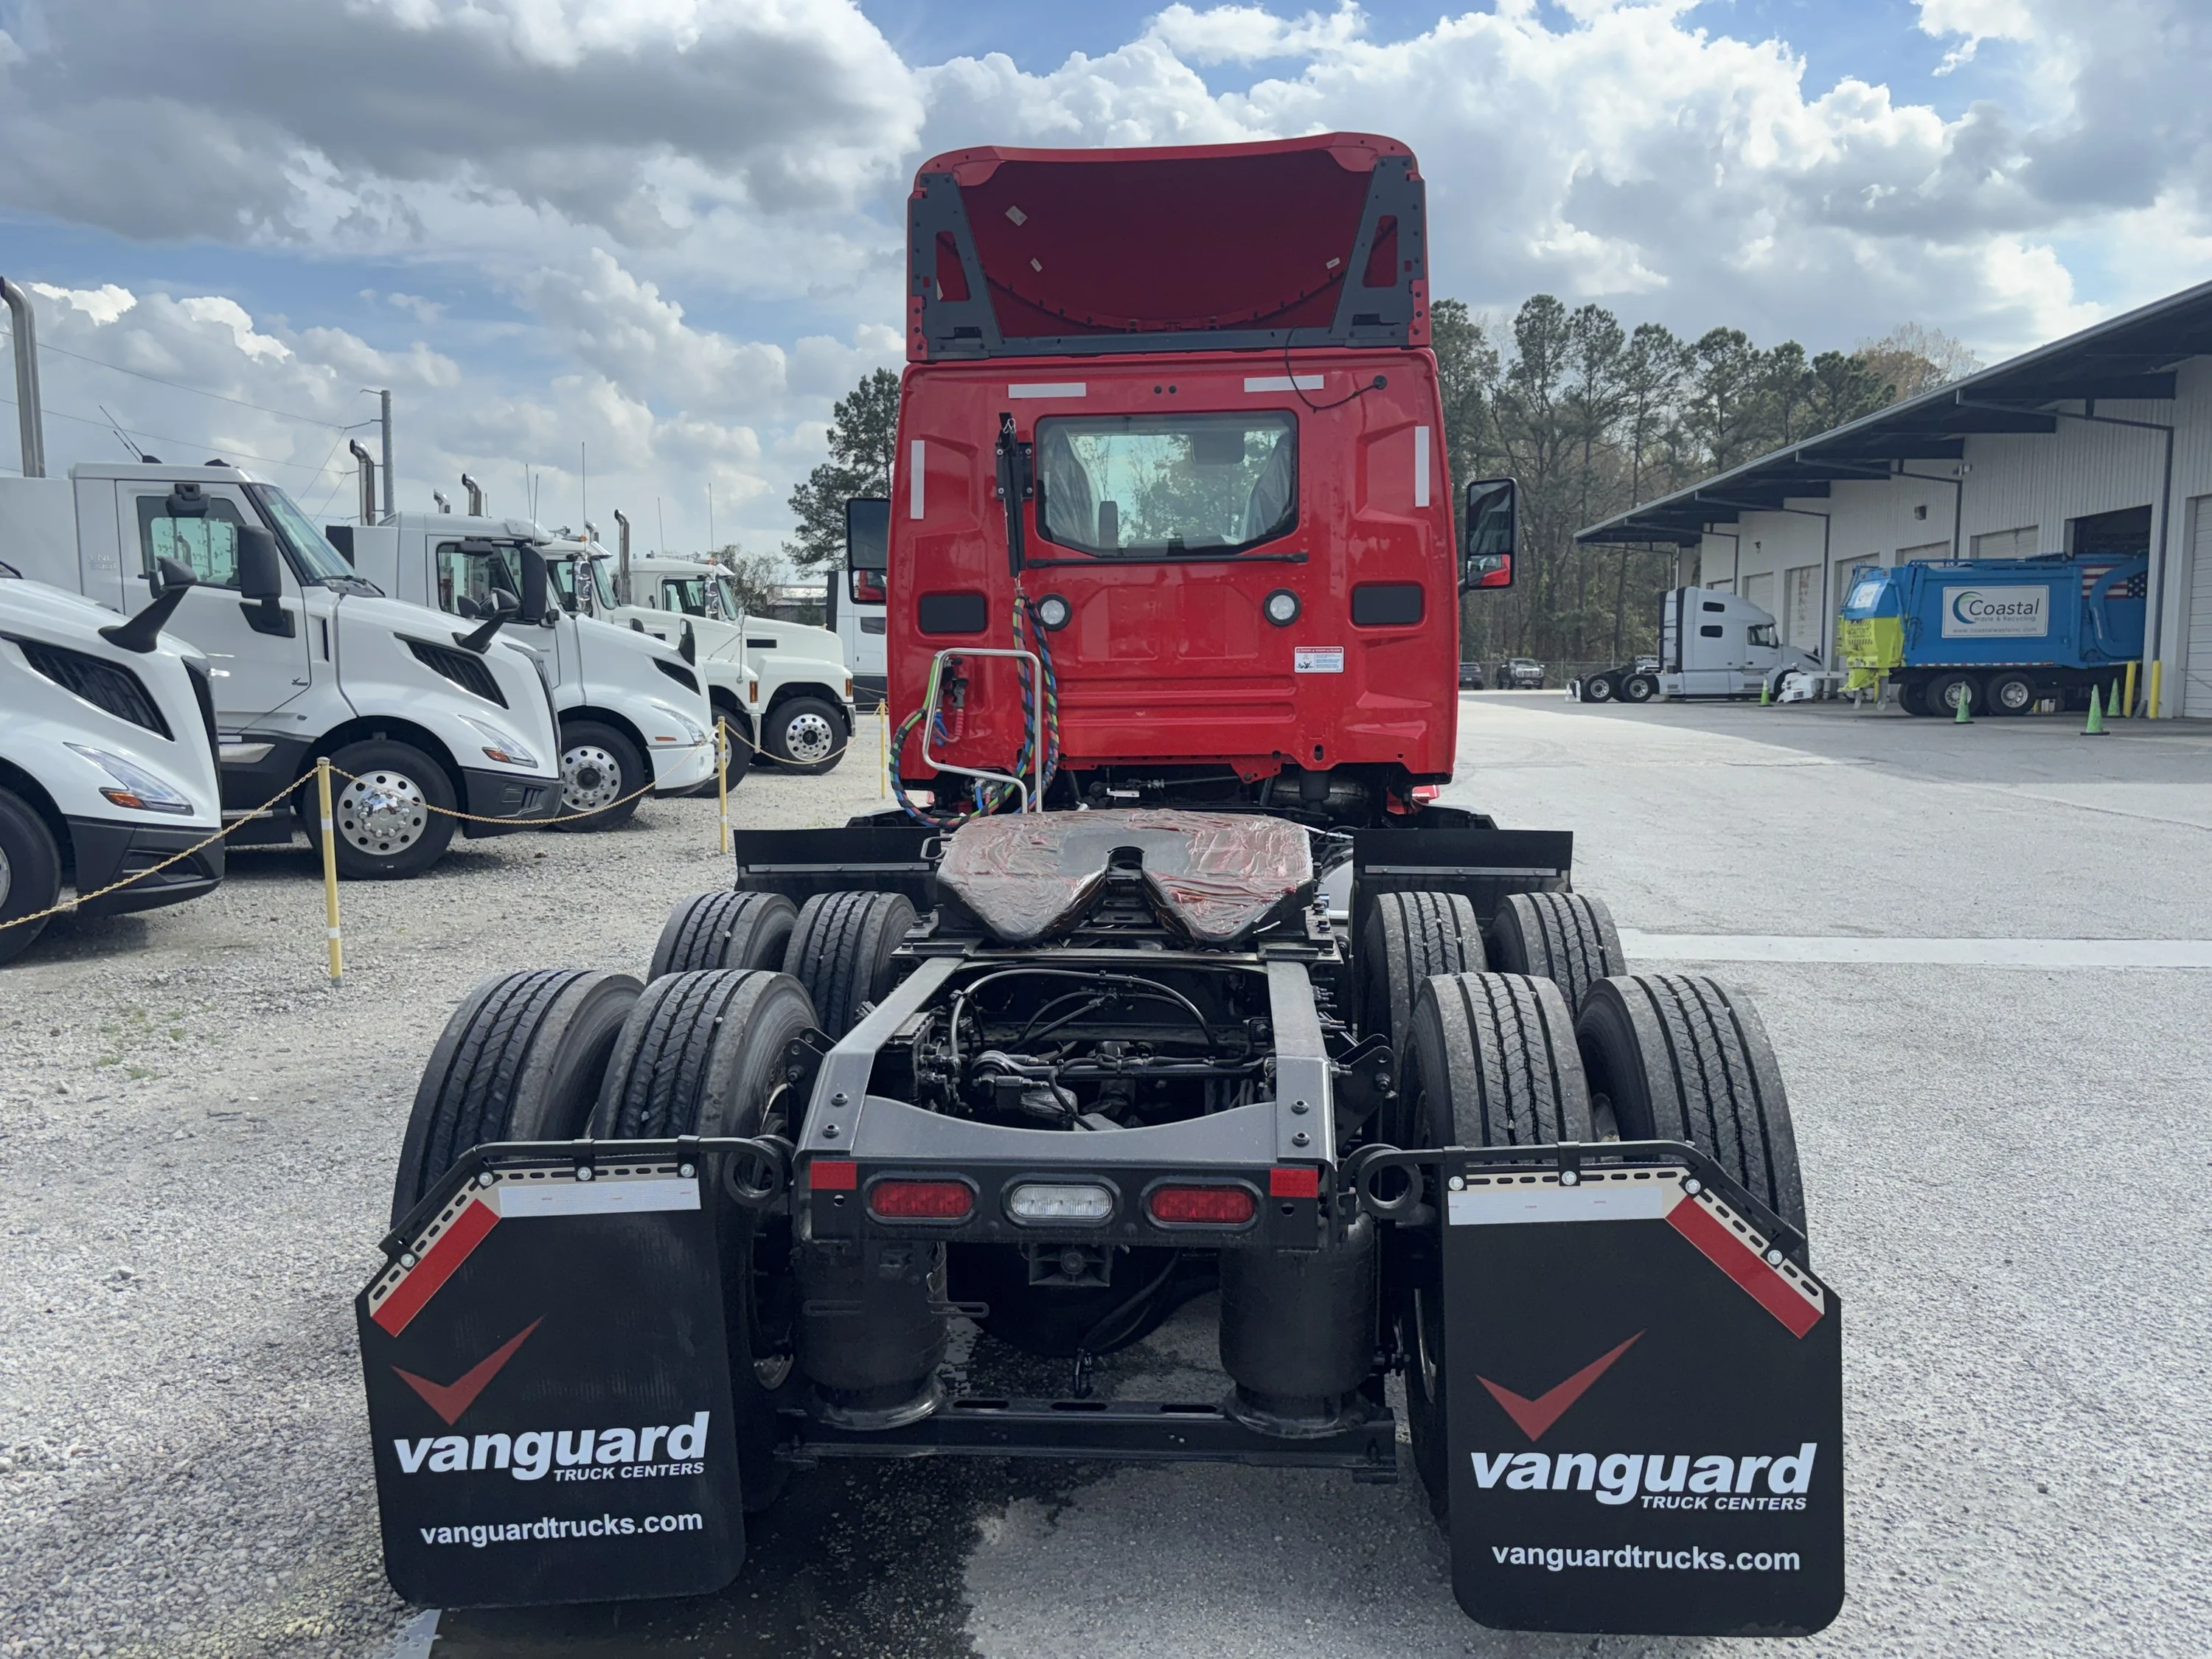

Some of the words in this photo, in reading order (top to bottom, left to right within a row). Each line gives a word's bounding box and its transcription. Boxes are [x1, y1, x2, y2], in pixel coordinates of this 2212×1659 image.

[1969, 598, 2040, 616] Coastal
[394, 1411, 710, 1481] vanguard
[554, 1467, 615, 1482] TRUCK
[620, 1461, 705, 1479] CENTERS
[1470, 1442, 1818, 1506] vanguard
[1641, 1495, 1708, 1510] TRUCK
[1714, 1497, 1807, 1511] CENTERS
[420, 1513, 703, 1548] vanguardtrucks.com
[1492, 1544, 1801, 1572] vanguardtrucks.com
